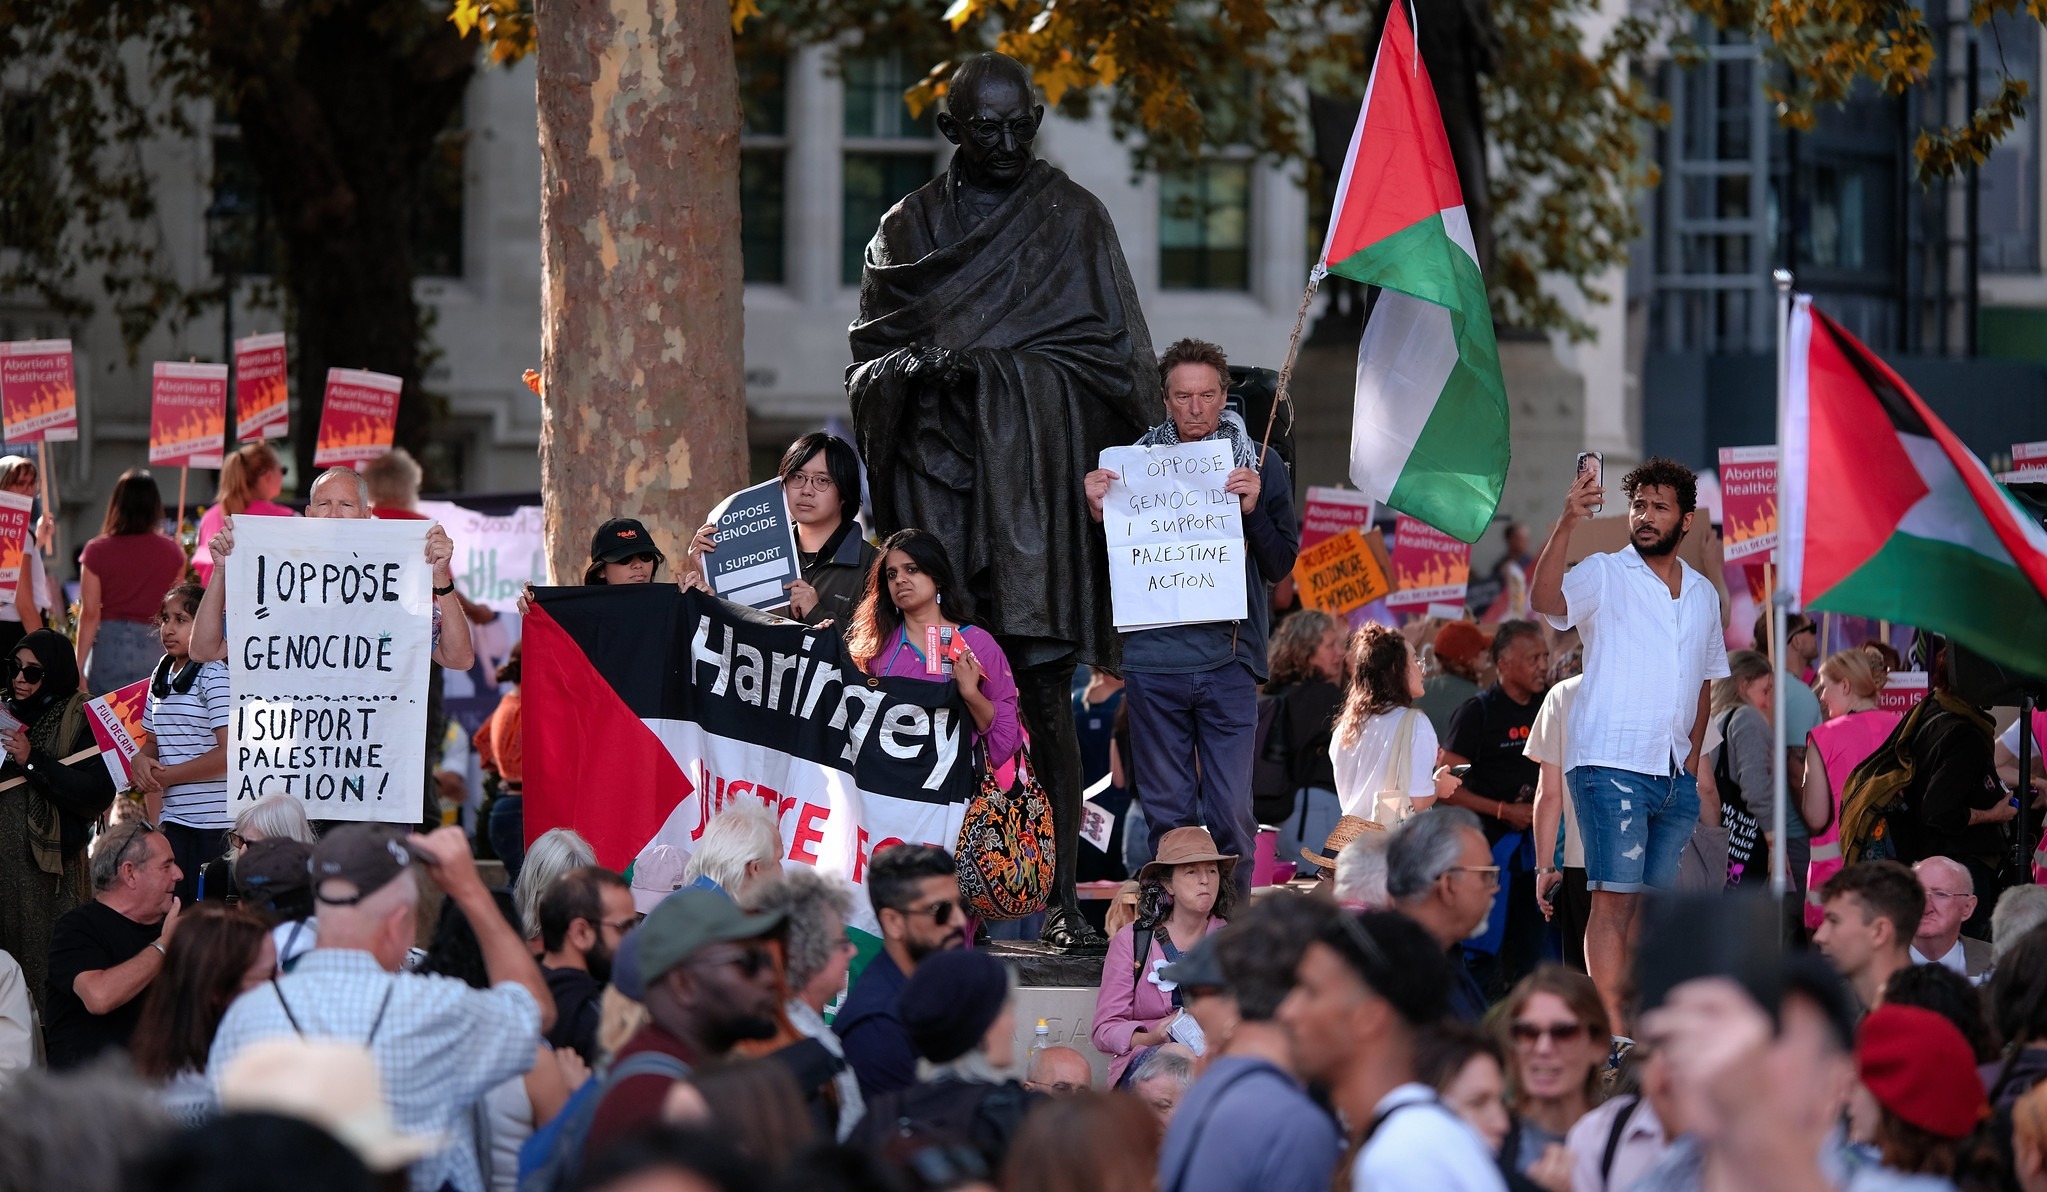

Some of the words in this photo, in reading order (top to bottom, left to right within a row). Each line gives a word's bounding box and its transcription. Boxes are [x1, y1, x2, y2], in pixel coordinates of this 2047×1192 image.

[4, 357, 53, 371] Abortion
[56, 355, 68, 368] IS
[273, 351, 281, 362] IS
[5, 370, 68, 383] healthcare!
[157, 380, 207, 394] Abortion
[210, 382, 221, 395] IS
[331, 385, 380, 404] Abortion
[382, 394, 394, 407] IS
[156, 394, 220, 407] healthcare!
[328, 398, 392, 417] healthcare!
[1122, 464, 1127, 487] I
[1147, 454, 1226, 477] OPPOSE
[12, 512, 24, 526] IS
[722, 502, 771, 526] OPPOSE
[1127, 522, 1132, 536] I
[1150, 513, 1232, 534] SUPPORT
[1308, 505, 1352, 521] Abortion
[1354, 509, 1365, 523] IS
[713, 516, 778, 543] GENOCIDE
[1132, 543, 1231, 566] PALESTINE
[1398, 534, 1466, 554] healthcare!
[1731, 544, 1749, 555] FULL
[718, 563, 723, 573] I
[726, 546, 781, 571] SUPPORT
[257, 554, 265, 605] I
[1148, 572, 1215, 592] ACTION
[243, 634, 392, 672] GENOCIDE
[691, 614, 961, 791] Haringey
[1881, 693, 1906, 706] tion
[1910, 692, 1922, 706] IS
[96, 704, 110, 725] FULL
[110, 723, 135, 755] DECRIM
[237, 706, 244, 741] I
[252, 708, 377, 741] SUPPORT
[238, 744, 383, 771] PALESTINE
[1720, 801, 1737, 819] My
[1722, 815, 1739, 833] My
[1739, 825, 1758, 840] Life
[1729, 831, 1754, 850] hoice
